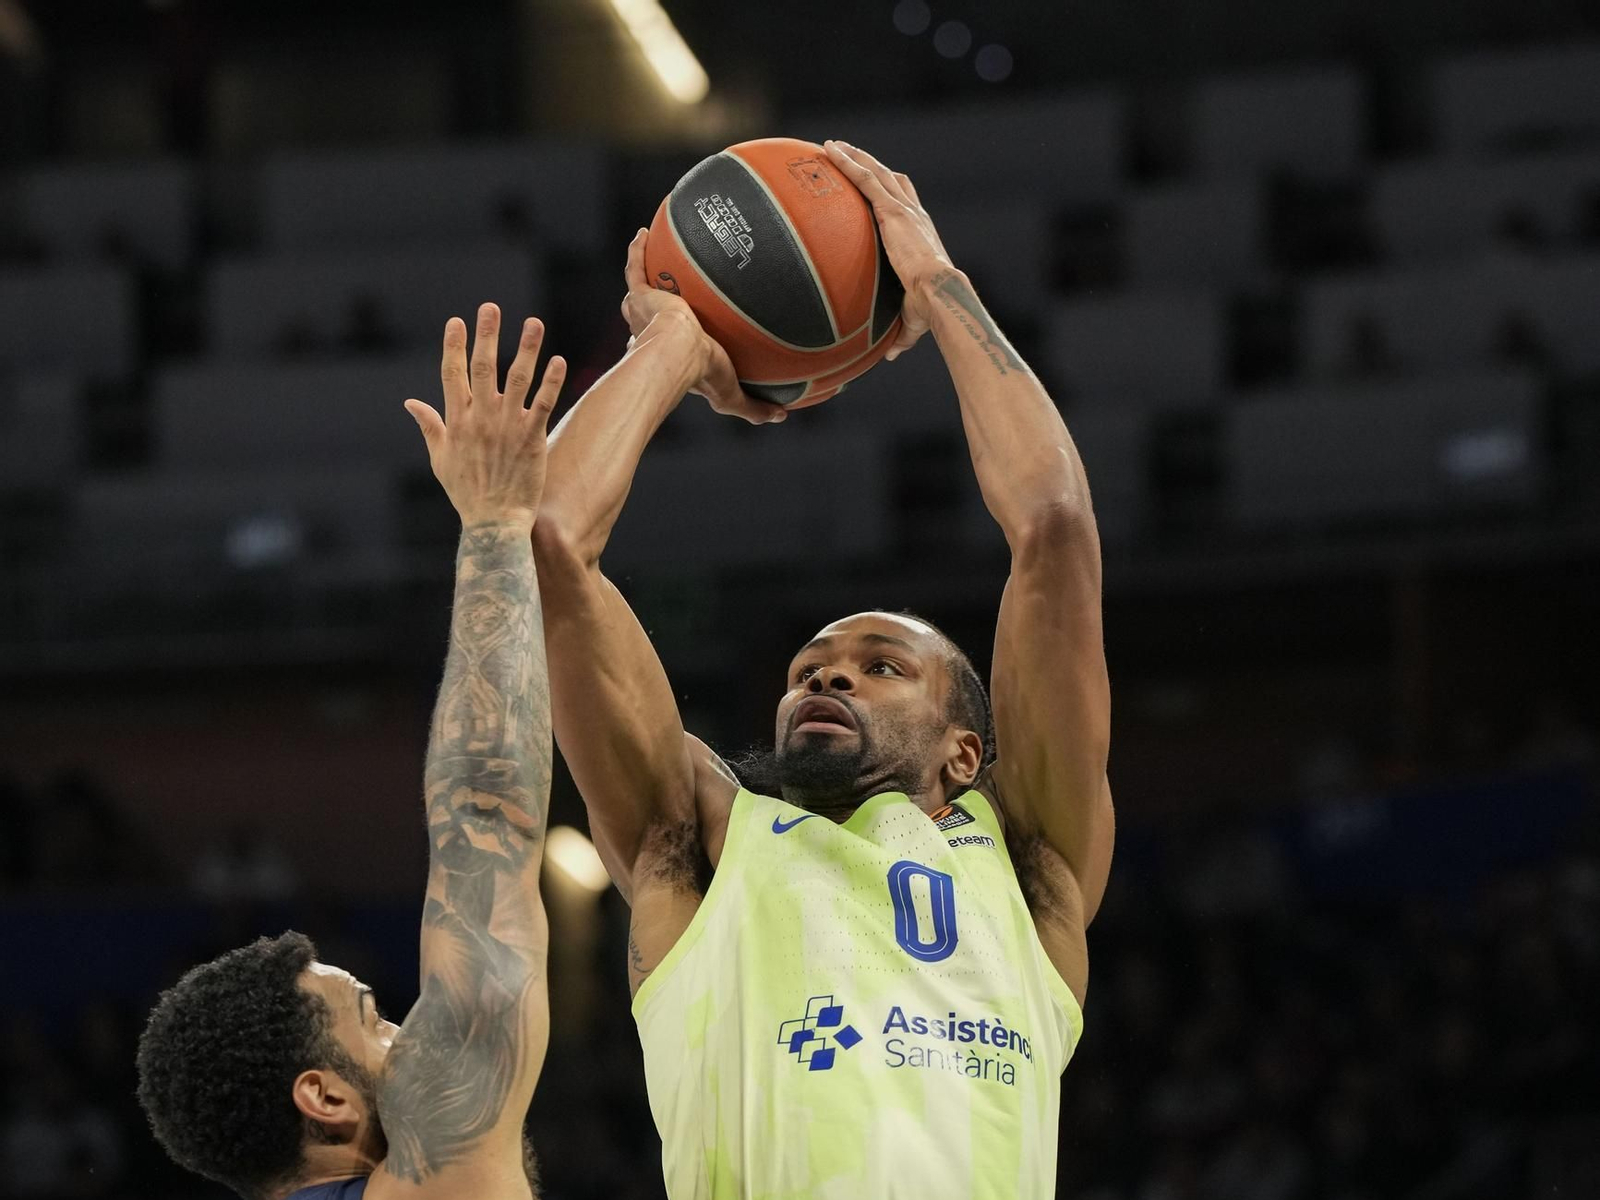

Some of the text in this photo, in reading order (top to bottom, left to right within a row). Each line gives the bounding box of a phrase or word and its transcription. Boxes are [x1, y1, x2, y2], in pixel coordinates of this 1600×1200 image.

[694, 198, 751, 269] LEGACY
[887, 860, 959, 963] 0
[882, 1006, 1034, 1065] Assistènci
[885, 1038, 1015, 1086] Sanitària
